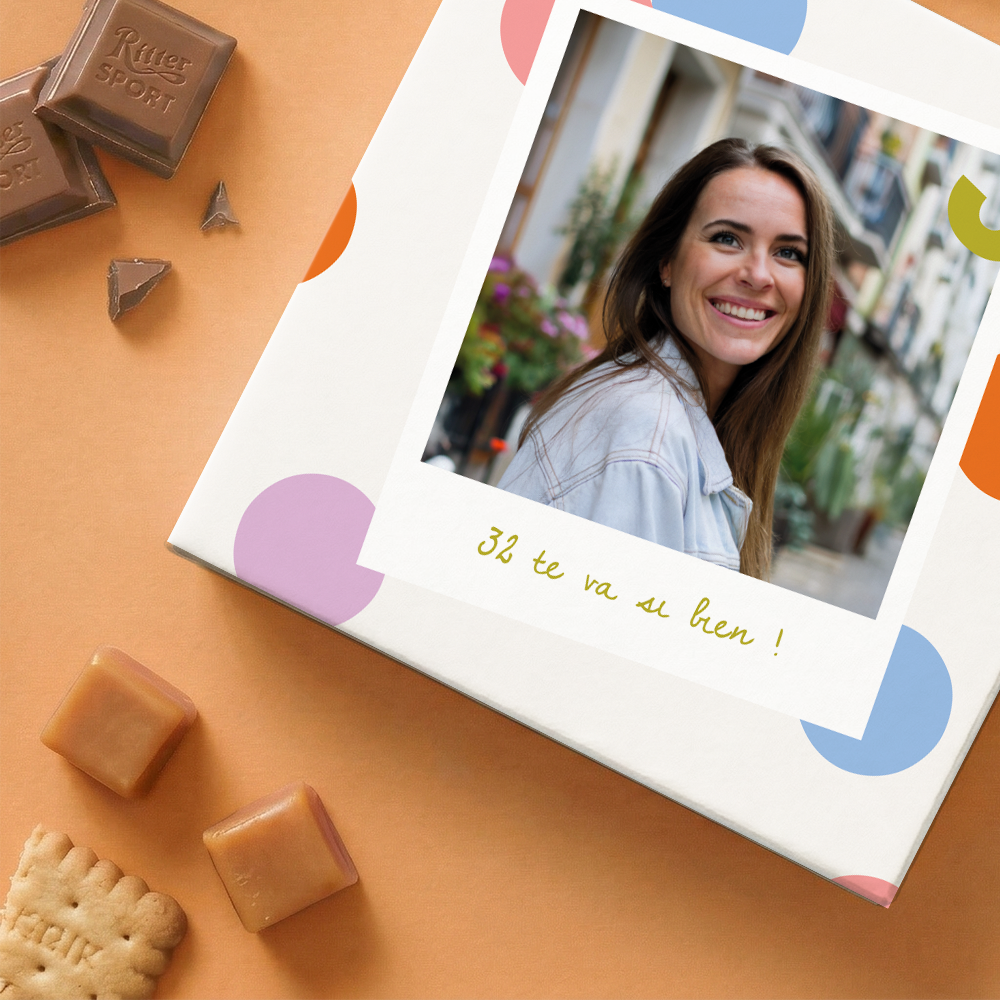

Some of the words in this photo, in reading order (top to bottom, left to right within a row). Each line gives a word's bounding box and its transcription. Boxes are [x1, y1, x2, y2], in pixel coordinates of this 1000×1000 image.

[105, 26, 193, 86] Ritter
[95, 62, 177, 114] SPORT
[0, 157, 41, 190] ORT
[477, 526, 519, 564] 32
[532, 549, 565, 580] te
[584, 574, 619, 601] va
[689, 596, 755, 646] bien
